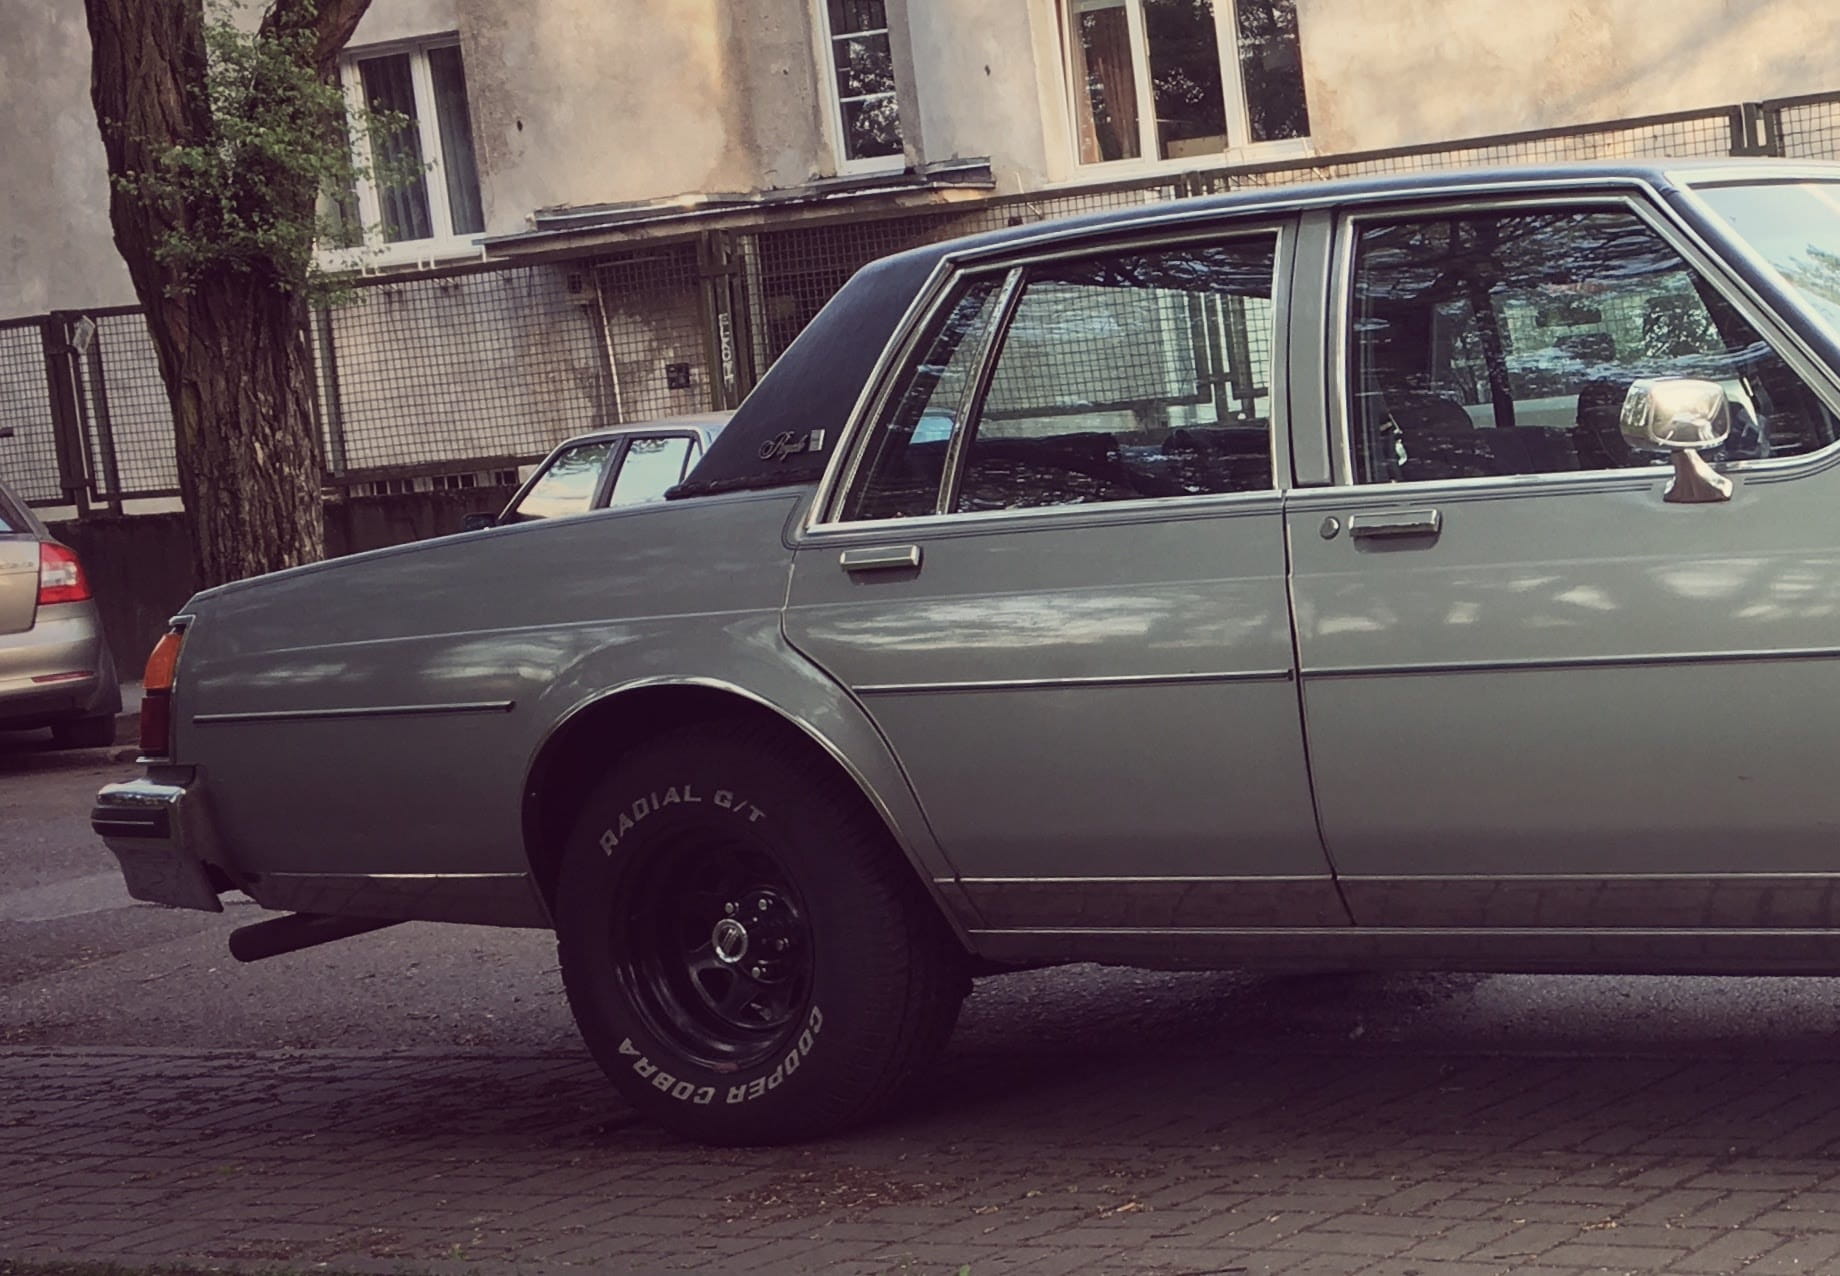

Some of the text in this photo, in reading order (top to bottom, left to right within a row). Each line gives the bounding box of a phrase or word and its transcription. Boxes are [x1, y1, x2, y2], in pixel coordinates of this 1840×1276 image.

[599, 784, 767, 857] RADIAL G/T
[617, 1004, 825, 1105] COOPER COBRA
